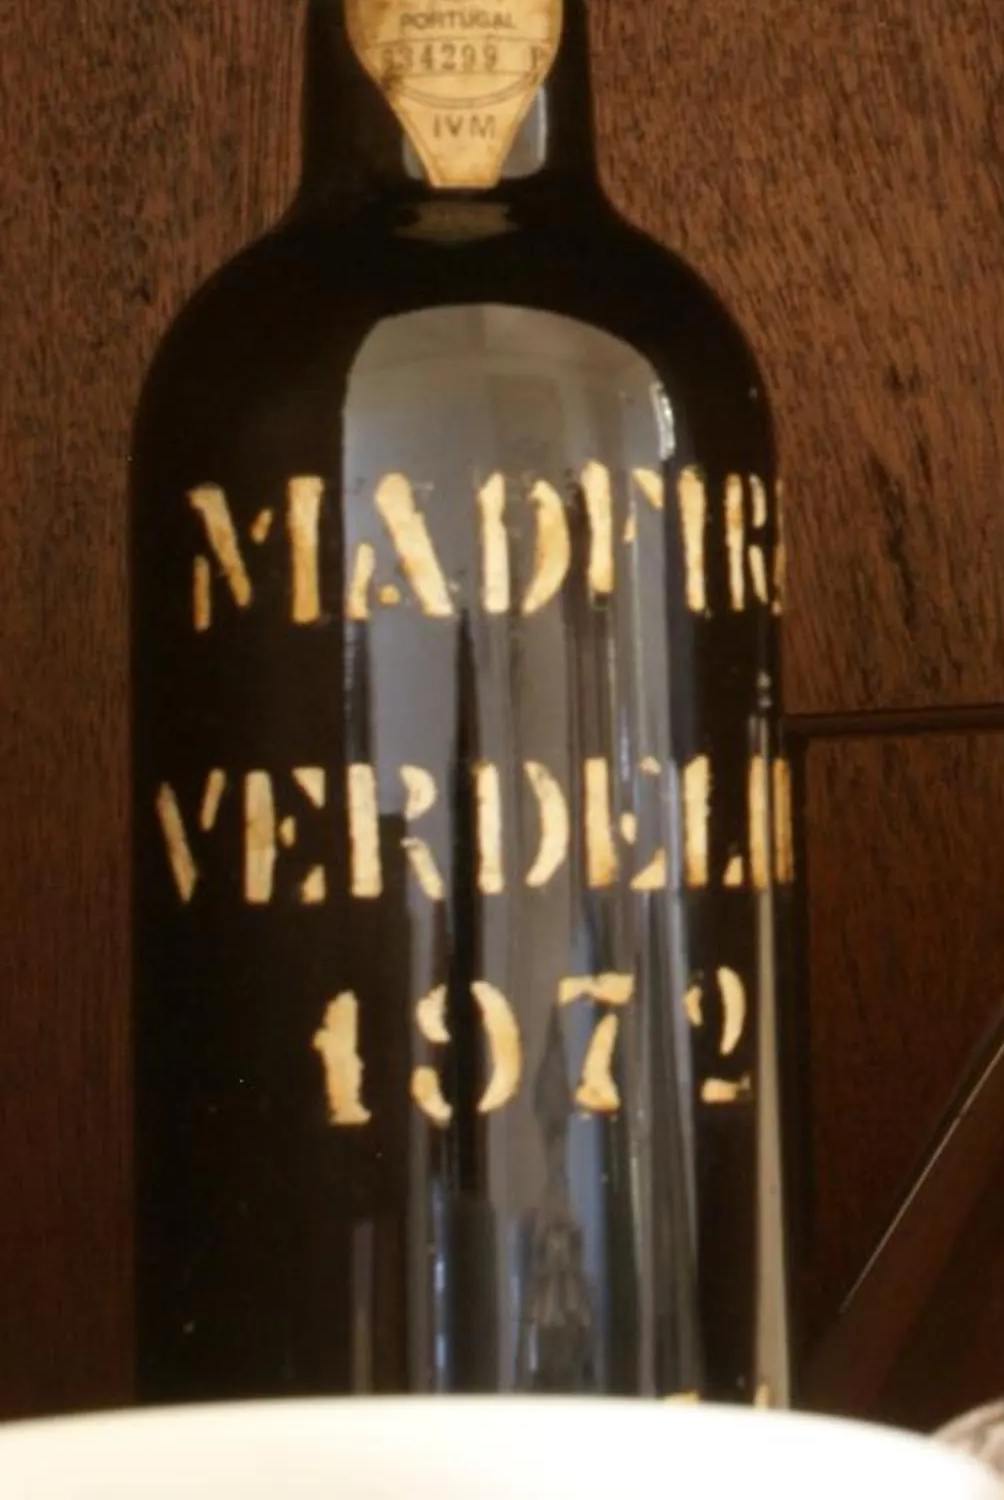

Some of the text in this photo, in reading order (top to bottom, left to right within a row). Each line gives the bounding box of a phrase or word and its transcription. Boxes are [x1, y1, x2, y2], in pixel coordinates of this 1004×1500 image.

[401, 10, 517, 31] PORTUGAL
[432, 112, 497, 139] IVM
[187, 460, 786, 631] MADEIR
[312, 966, 751, 1129] 1972
